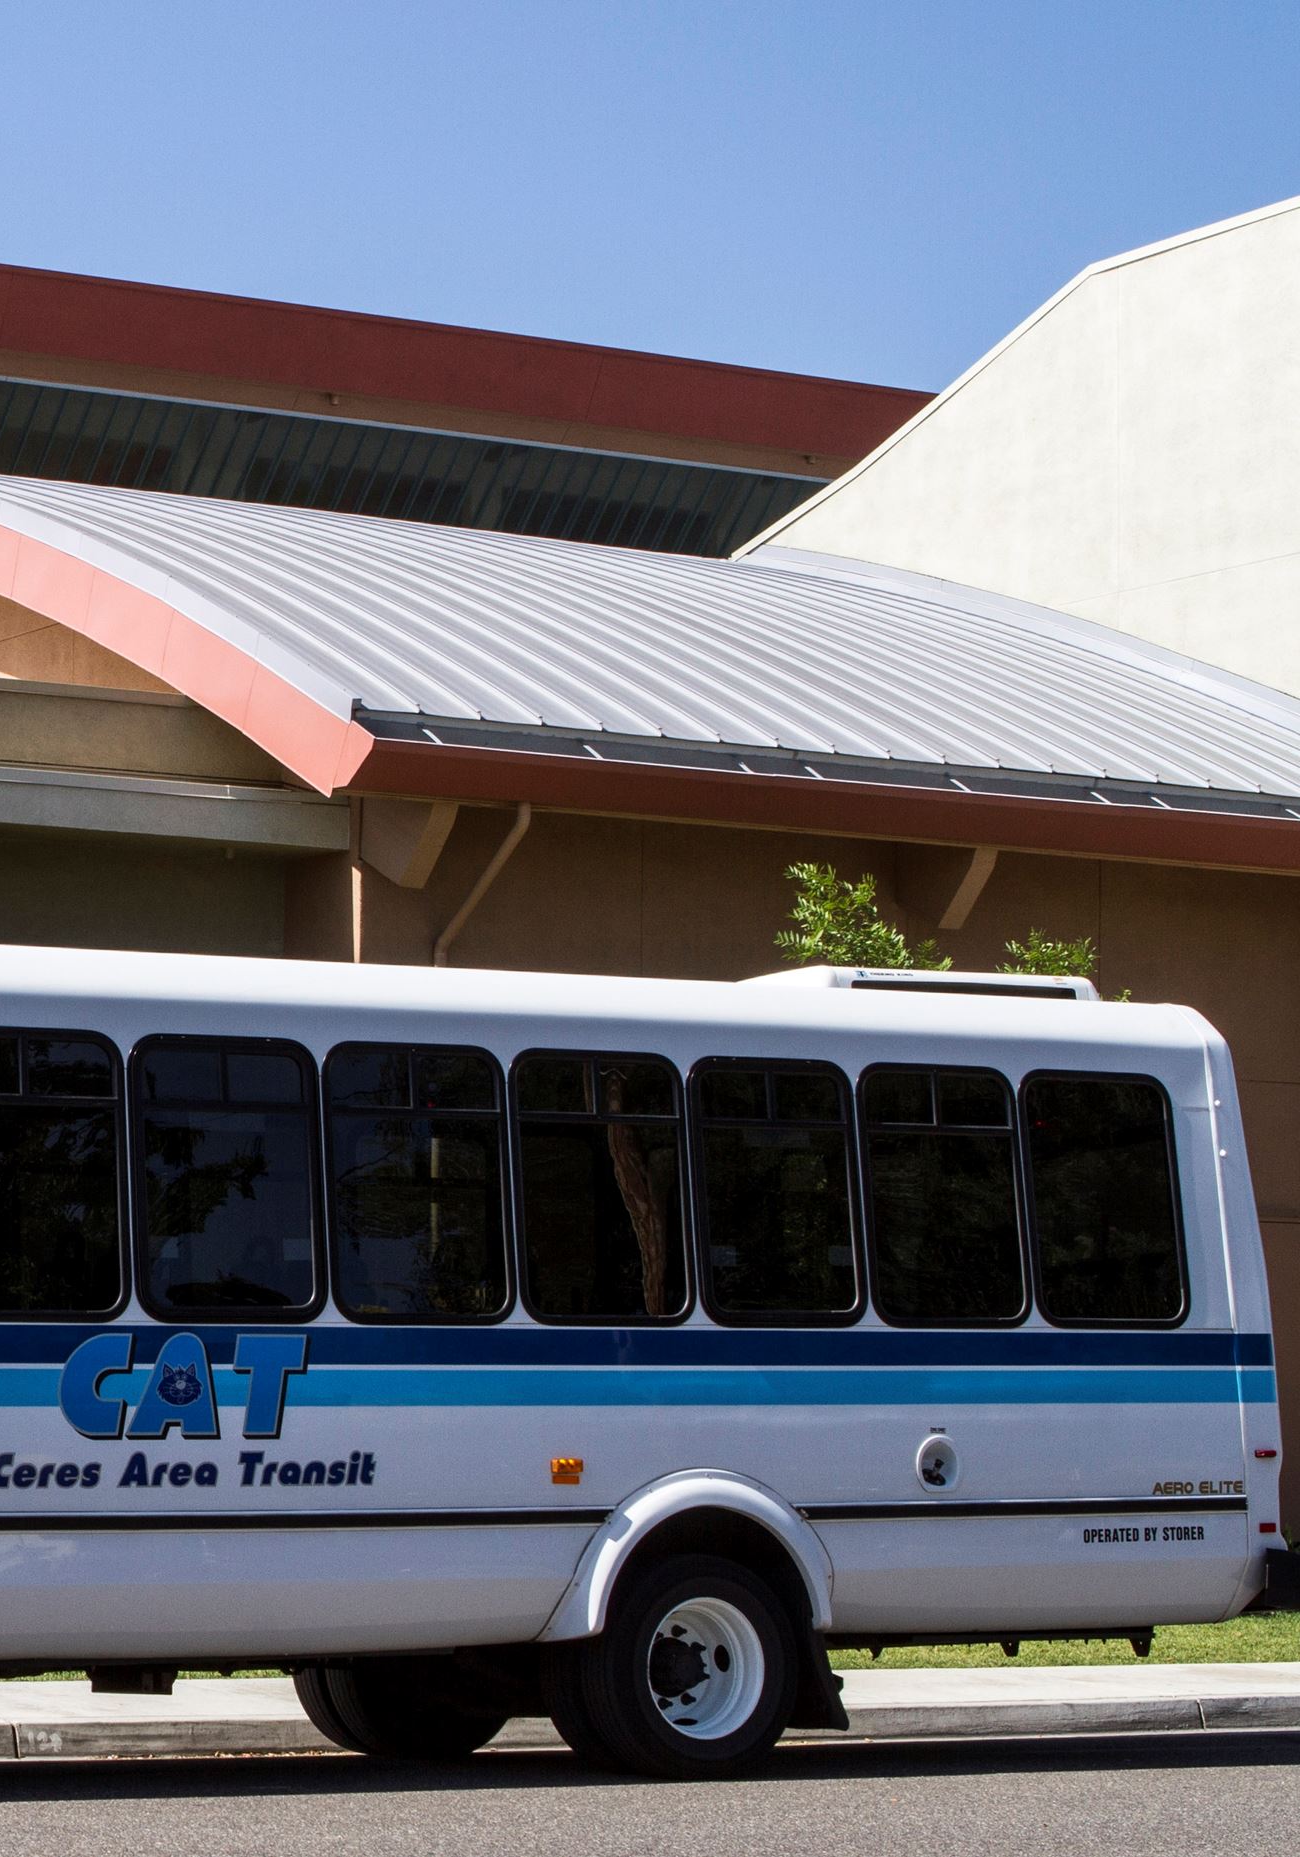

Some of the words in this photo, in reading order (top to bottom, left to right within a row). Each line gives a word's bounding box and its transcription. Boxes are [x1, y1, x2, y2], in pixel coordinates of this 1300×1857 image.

[58, 1332, 310, 1440] CAT
[116, 1451, 219, 1488] Area
[237, 1450, 376, 1487] Transit
[1152, 1482, 1194, 1495] AERO
[1199, 1480, 1244, 1494] ELITE
[1083, 1528, 1140, 1543] OPERATED
[1144, 1527, 1158, 1542] BY
[1162, 1526, 1205, 1541] STORER
